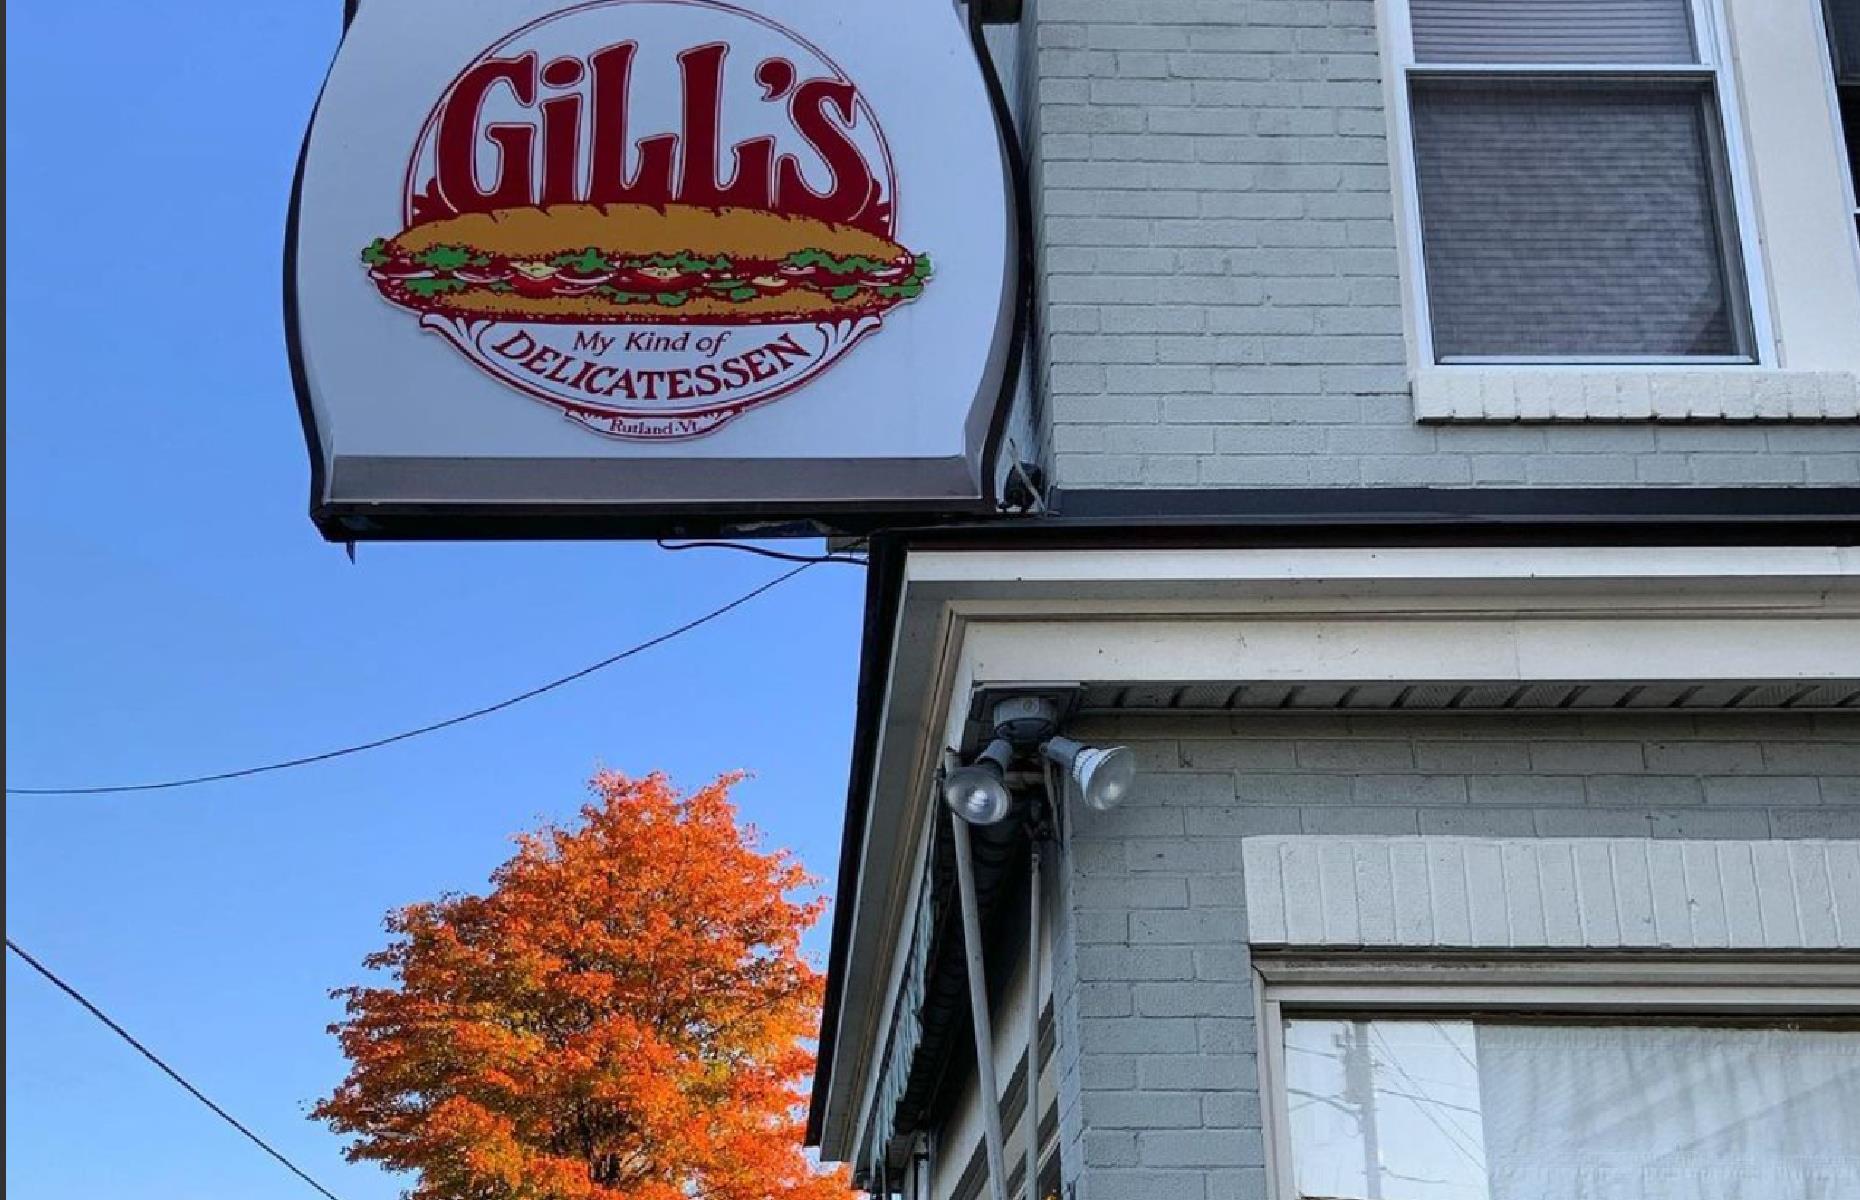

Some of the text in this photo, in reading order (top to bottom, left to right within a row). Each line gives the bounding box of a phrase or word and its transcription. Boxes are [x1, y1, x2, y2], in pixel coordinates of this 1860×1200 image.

[491, 330, 813, 401] DELICATESSEN
[573, 330, 731, 354] My Kind of
